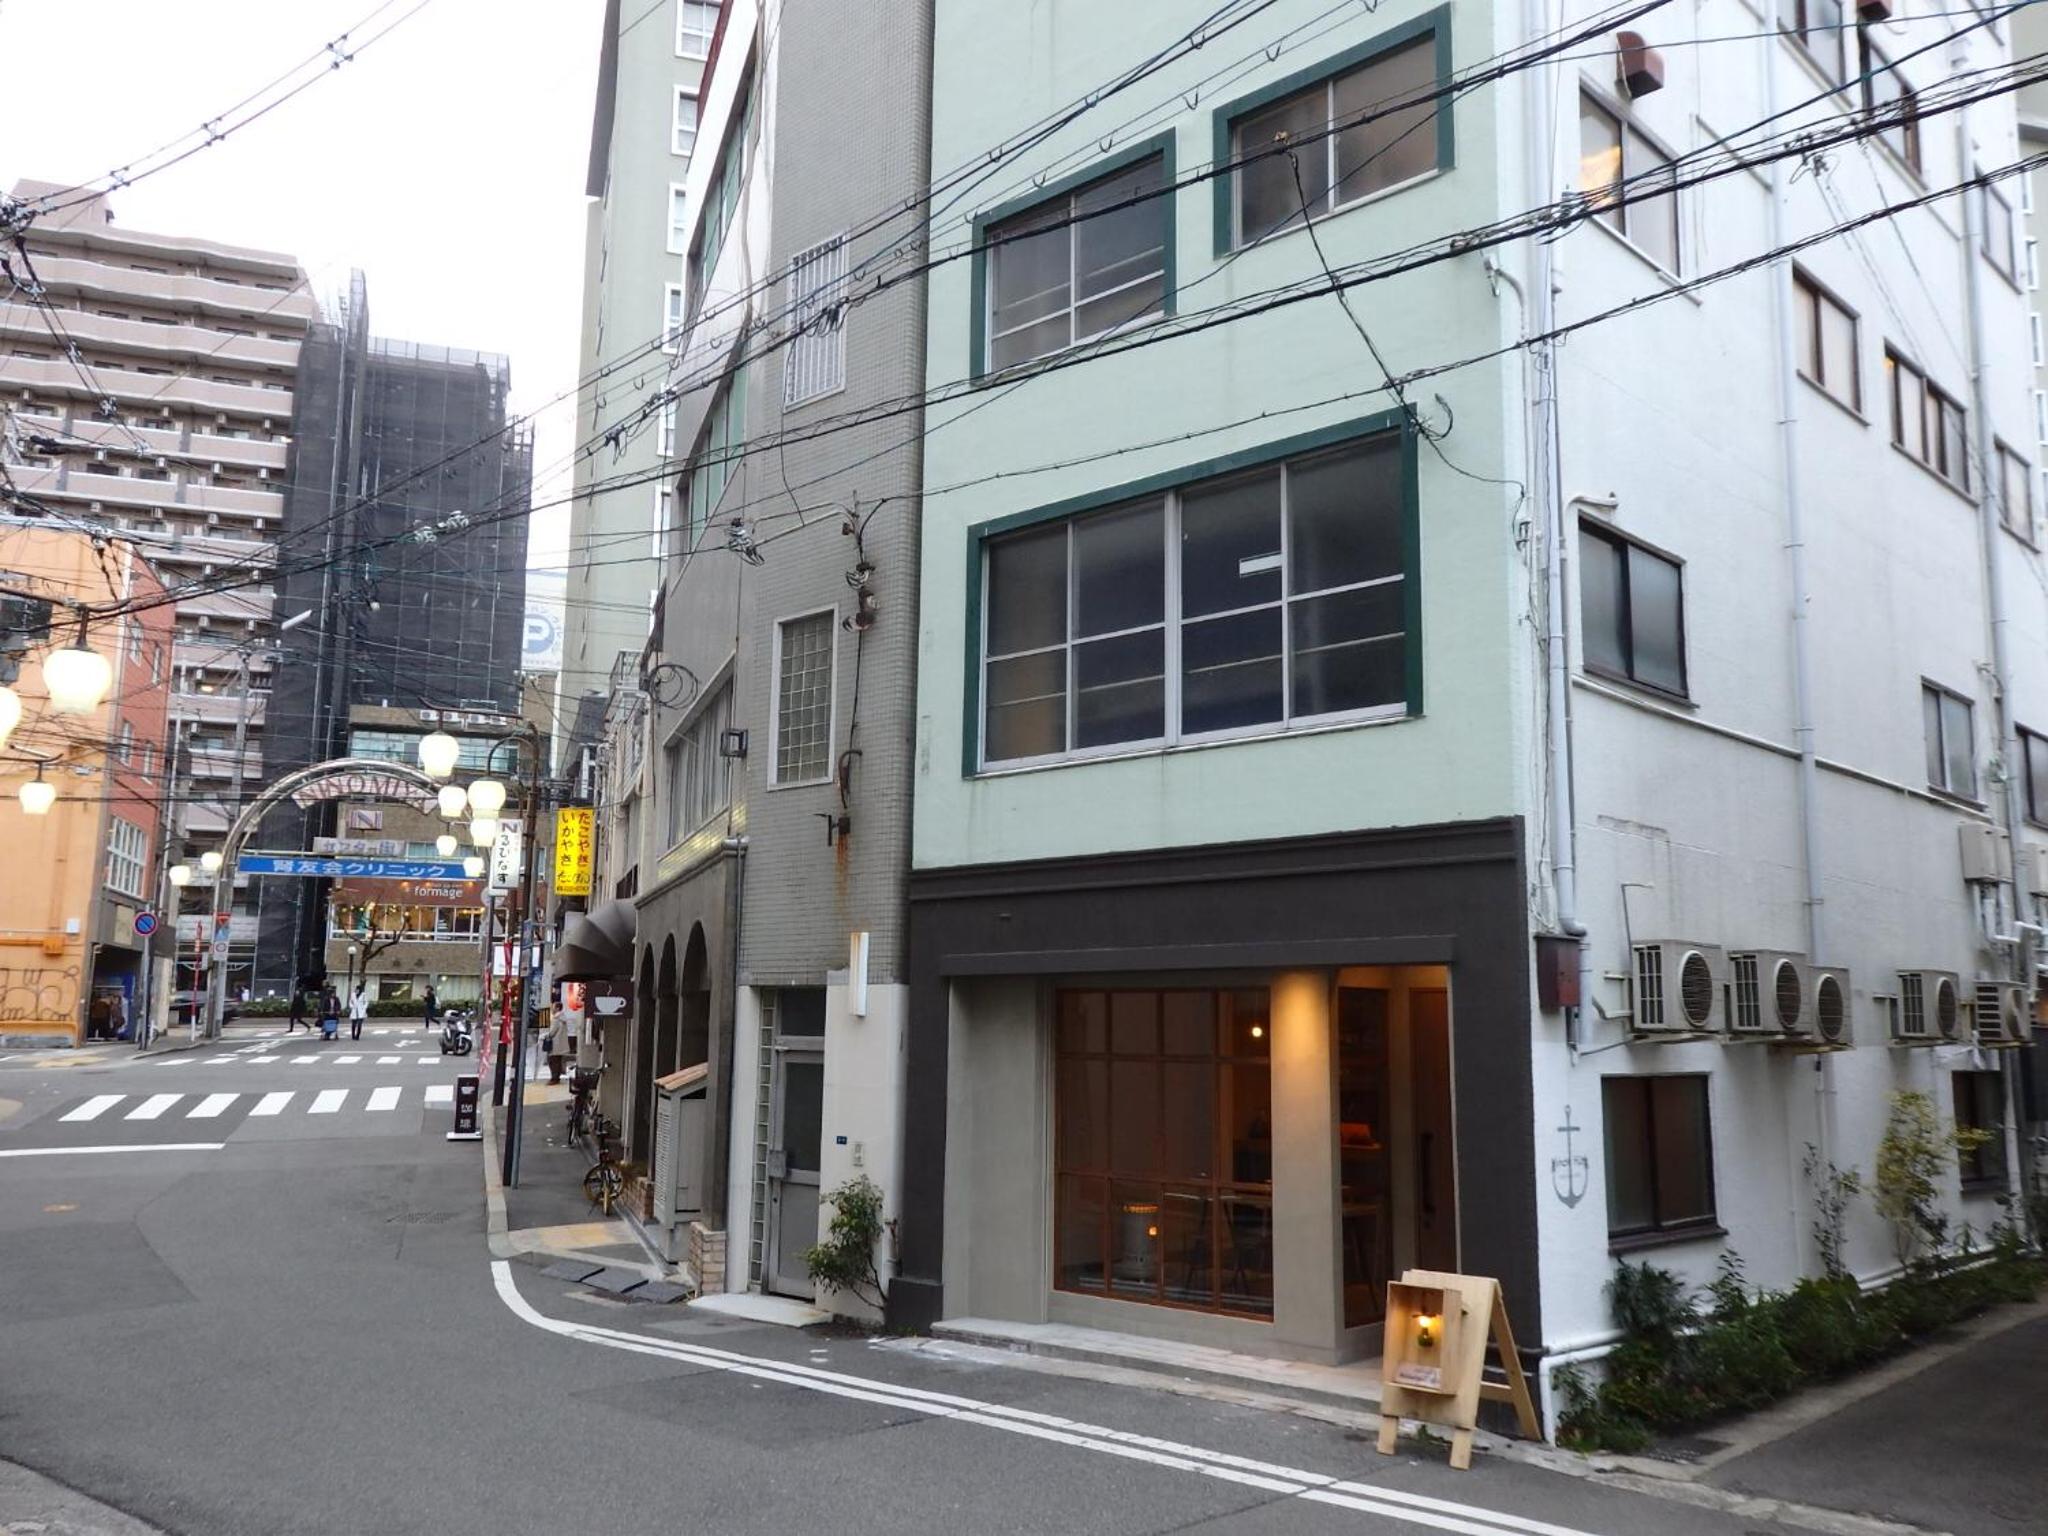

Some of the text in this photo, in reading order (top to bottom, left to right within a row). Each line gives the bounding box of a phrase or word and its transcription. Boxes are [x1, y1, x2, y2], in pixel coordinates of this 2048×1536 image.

[561, 812, 574, 867] いかやき
[577, 812, 590, 867] たこやき
[414, 885, 463, 899] formage
